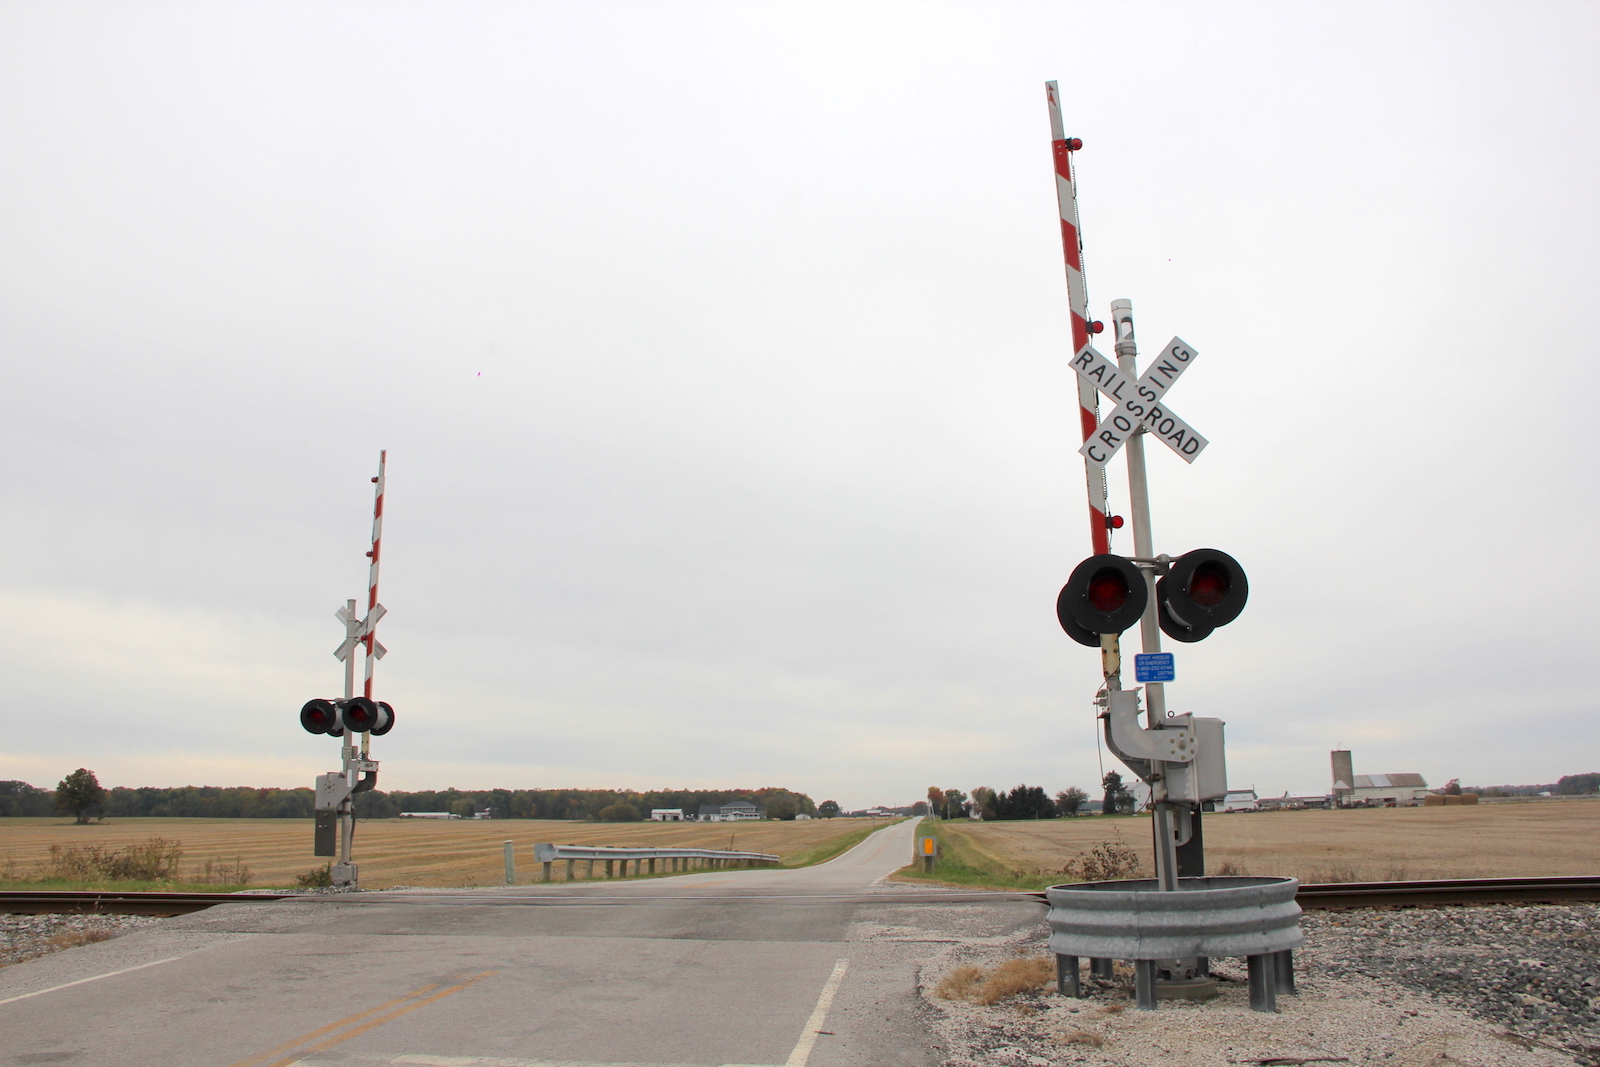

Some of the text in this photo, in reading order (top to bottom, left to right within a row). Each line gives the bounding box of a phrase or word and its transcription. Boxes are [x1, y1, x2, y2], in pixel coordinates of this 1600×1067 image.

[1075, 350, 1200, 455] RAIL ROAD
[1087, 346, 1190, 463] CROSSING
